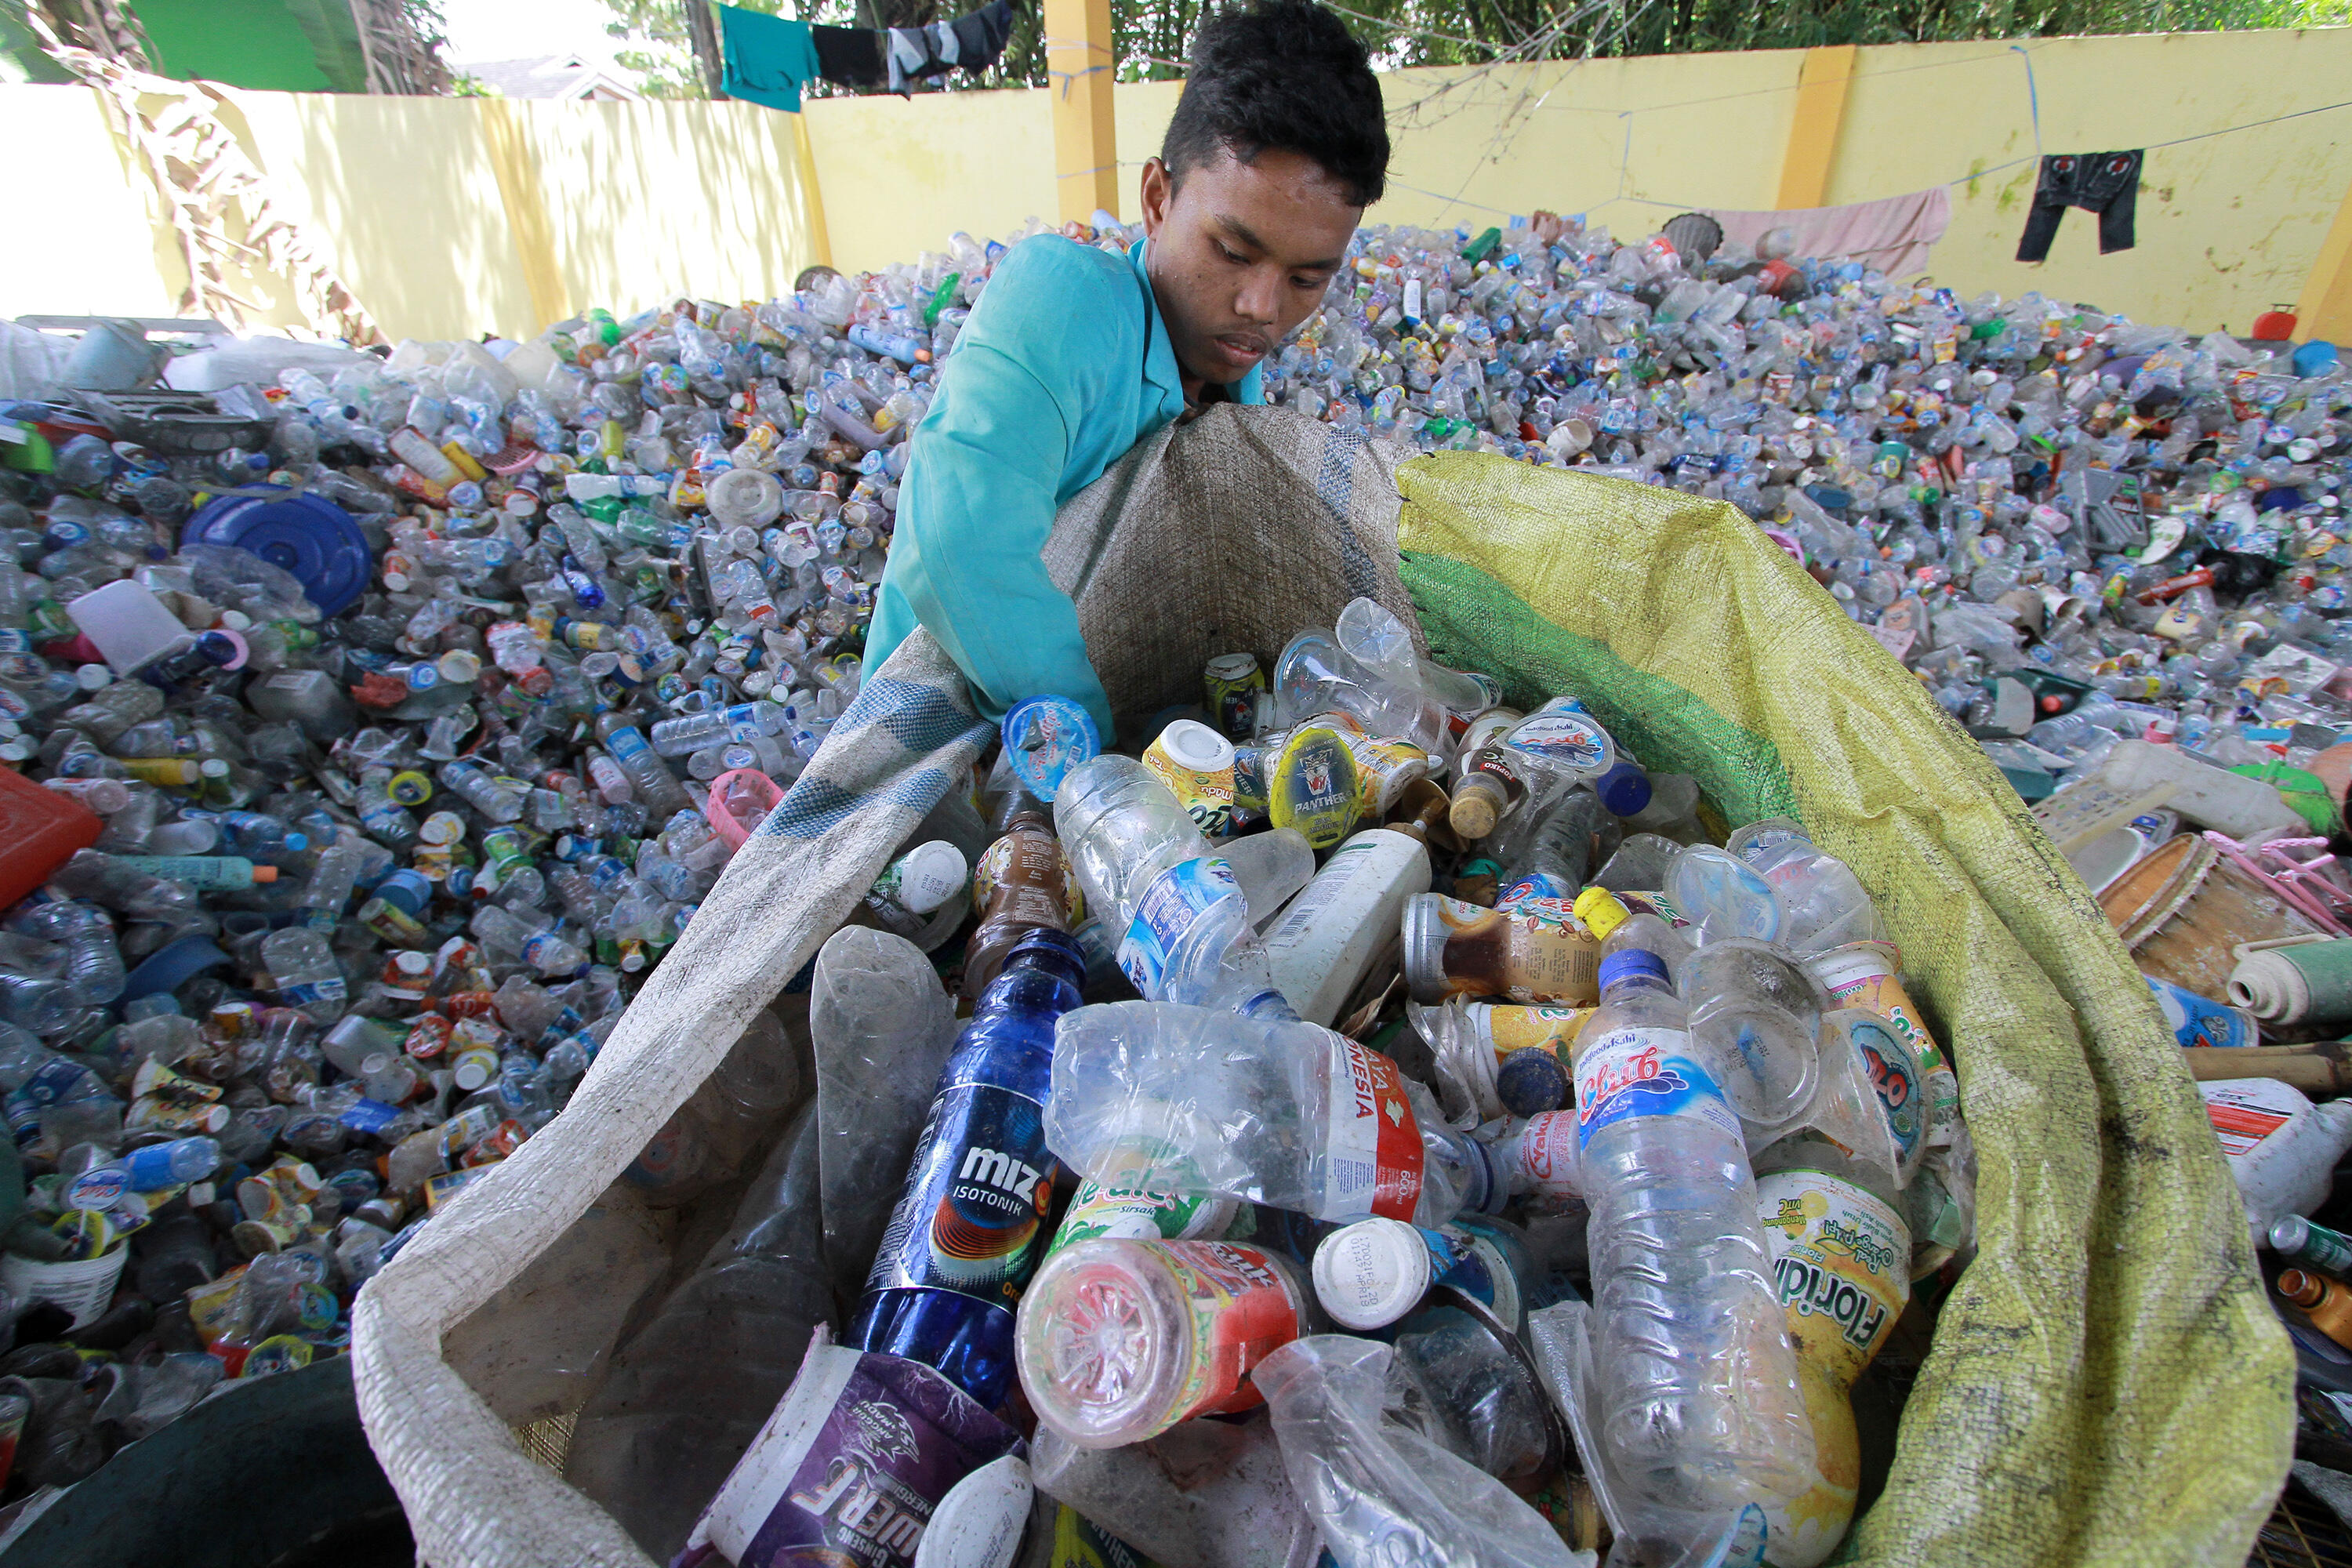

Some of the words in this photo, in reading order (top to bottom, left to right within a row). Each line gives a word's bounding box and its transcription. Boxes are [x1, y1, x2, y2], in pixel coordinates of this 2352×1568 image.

[1483, 762, 1514, 781] KOPIKO
[1199, 782, 1235, 802] madu
[1294, 793, 1347, 815] PANTHER
[1581, 1046, 1661, 1125] Club
[952, 1184, 1025, 1218] ISOTONIK
[1119, 1204, 1157, 1217] sirsak
[1762, 1214, 1807, 1229] Mengandung
[1823, 1219, 1856, 1247] Pulp!
[1853, 1232, 1894, 1268] Orange
[1853, 1247, 1882, 1275] Real
[1773, 1258, 1888, 1352] Florid
[851, 1406, 894, 1439] ANGGUR
[894, 1486, 936, 1516] NERGI
[837, 1526, 889, 1568] GINSENG
